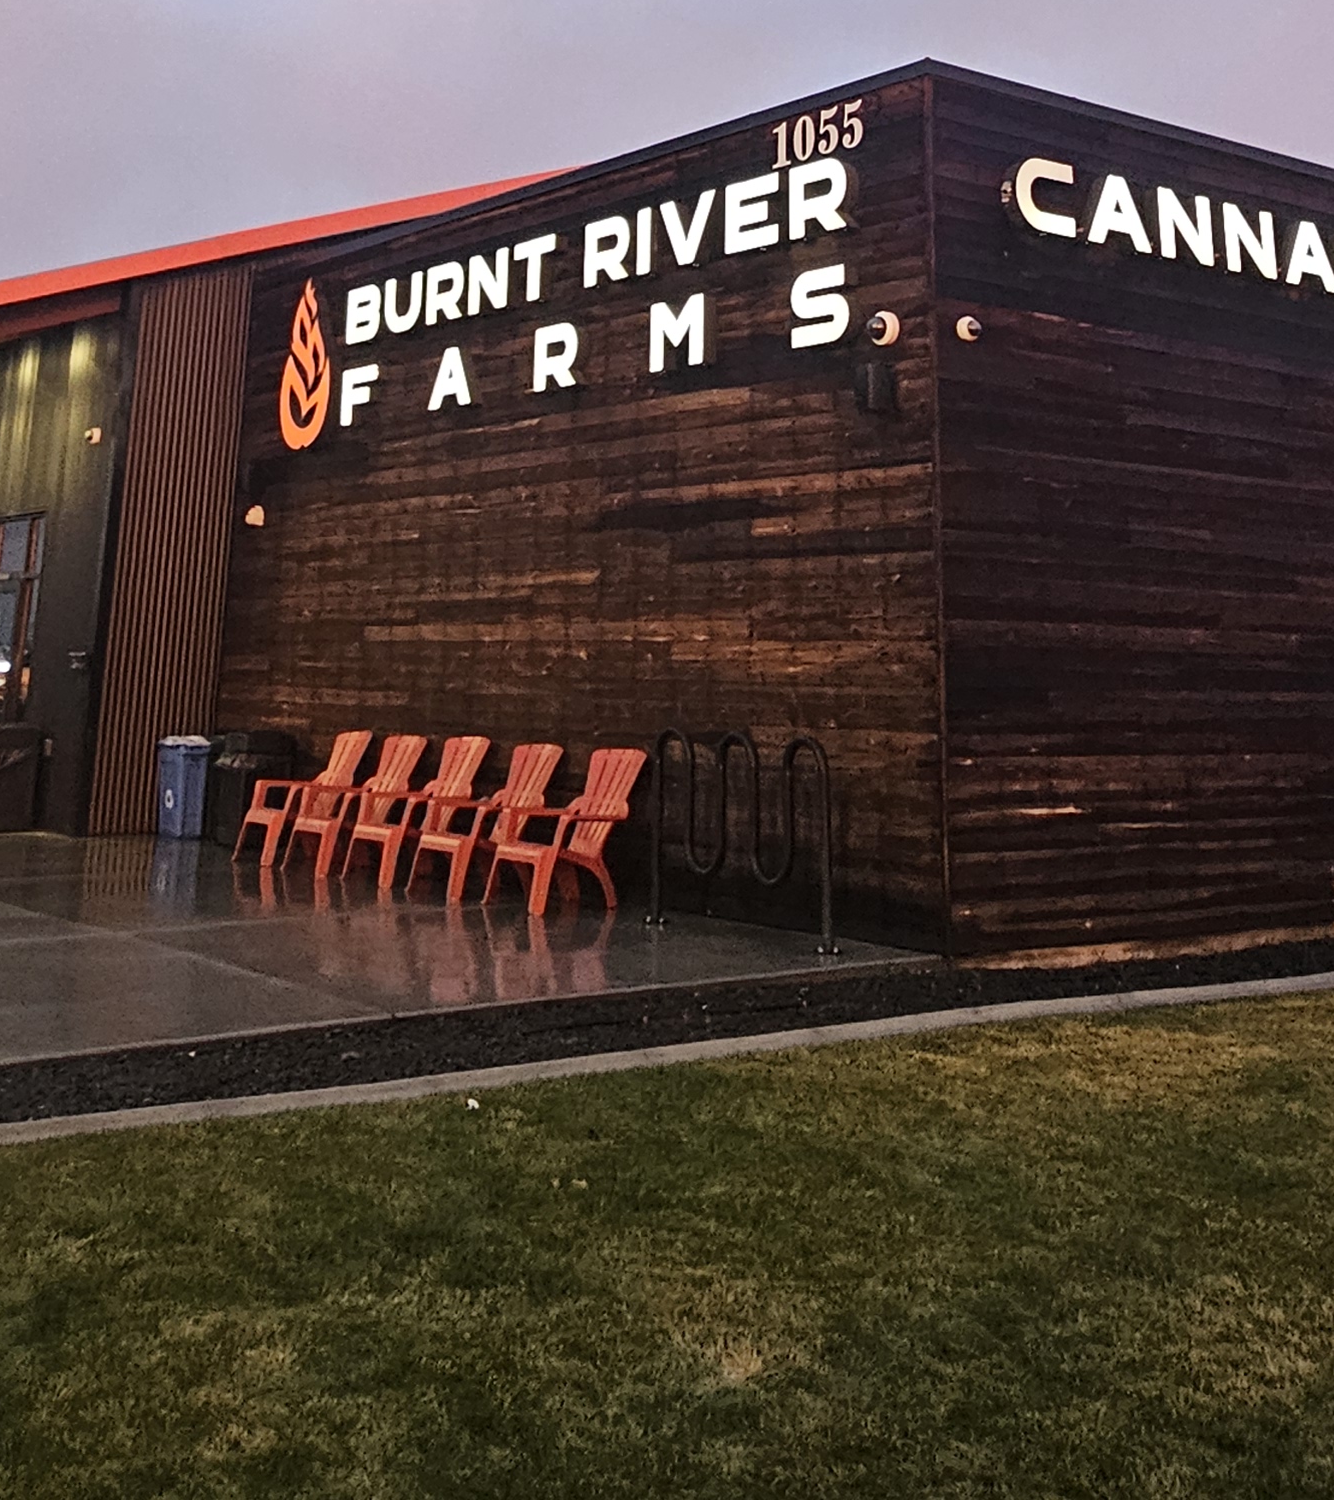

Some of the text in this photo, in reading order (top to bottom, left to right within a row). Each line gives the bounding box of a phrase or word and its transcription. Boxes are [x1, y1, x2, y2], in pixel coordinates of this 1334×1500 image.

[771, 98, 864, 170] 1055
[345, 156, 848, 346] BURNT RIVER
[338, 262, 851, 428] FARMS
